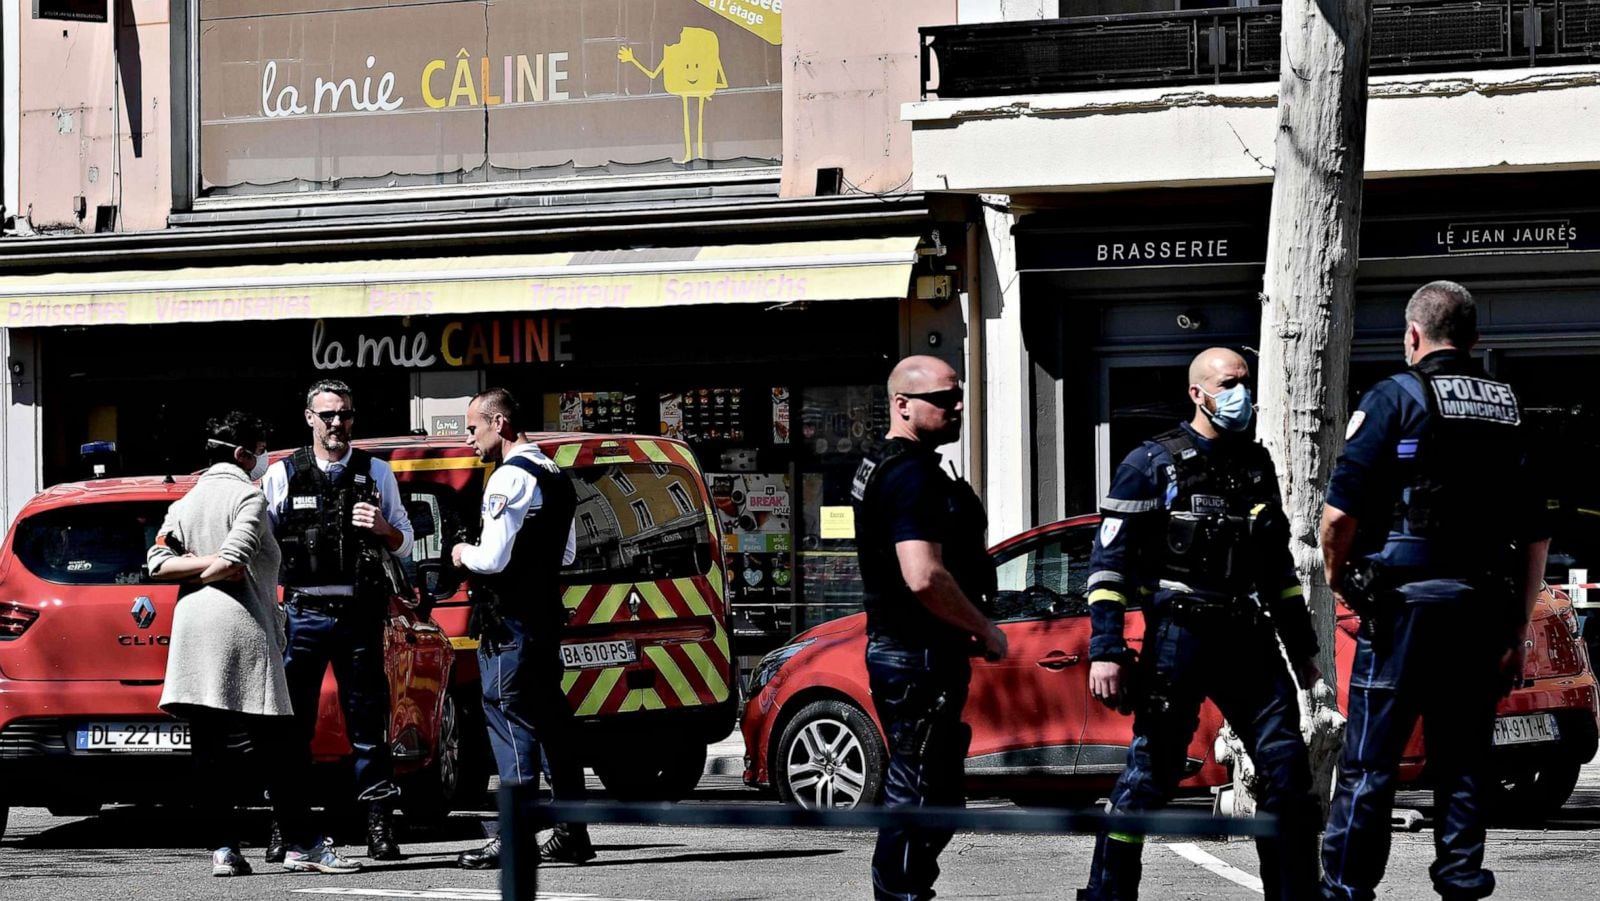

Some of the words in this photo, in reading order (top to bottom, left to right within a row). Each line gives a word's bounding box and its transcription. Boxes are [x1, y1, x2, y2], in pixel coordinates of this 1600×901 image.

[262, 61, 308, 118] la
[313, 55, 404, 114] mie
[420, 47, 570, 109] CÂLINE
[1437, 231, 1454, 244] LE
[1462, 229, 1505, 243] JEAN
[1097, 240, 1228, 261] BRASSERIE
[7, 299, 128, 323] Pâtisseries
[155, 292, 312, 320] Viennoiseries
[368, 288, 435, 313] Pains
[529, 281, 633, 306] Traiteur
[664, 273, 809, 301] Sandwichs
[312, 319, 353, 369] la
[356, 317, 437, 368] mie
[1435, 379, 1513, 405] POLICE
[1443, 400, 1516, 421] MUNICIPALE
[293, 496, 317, 504] POLICE
[1195, 497, 1225, 507] POLICE
